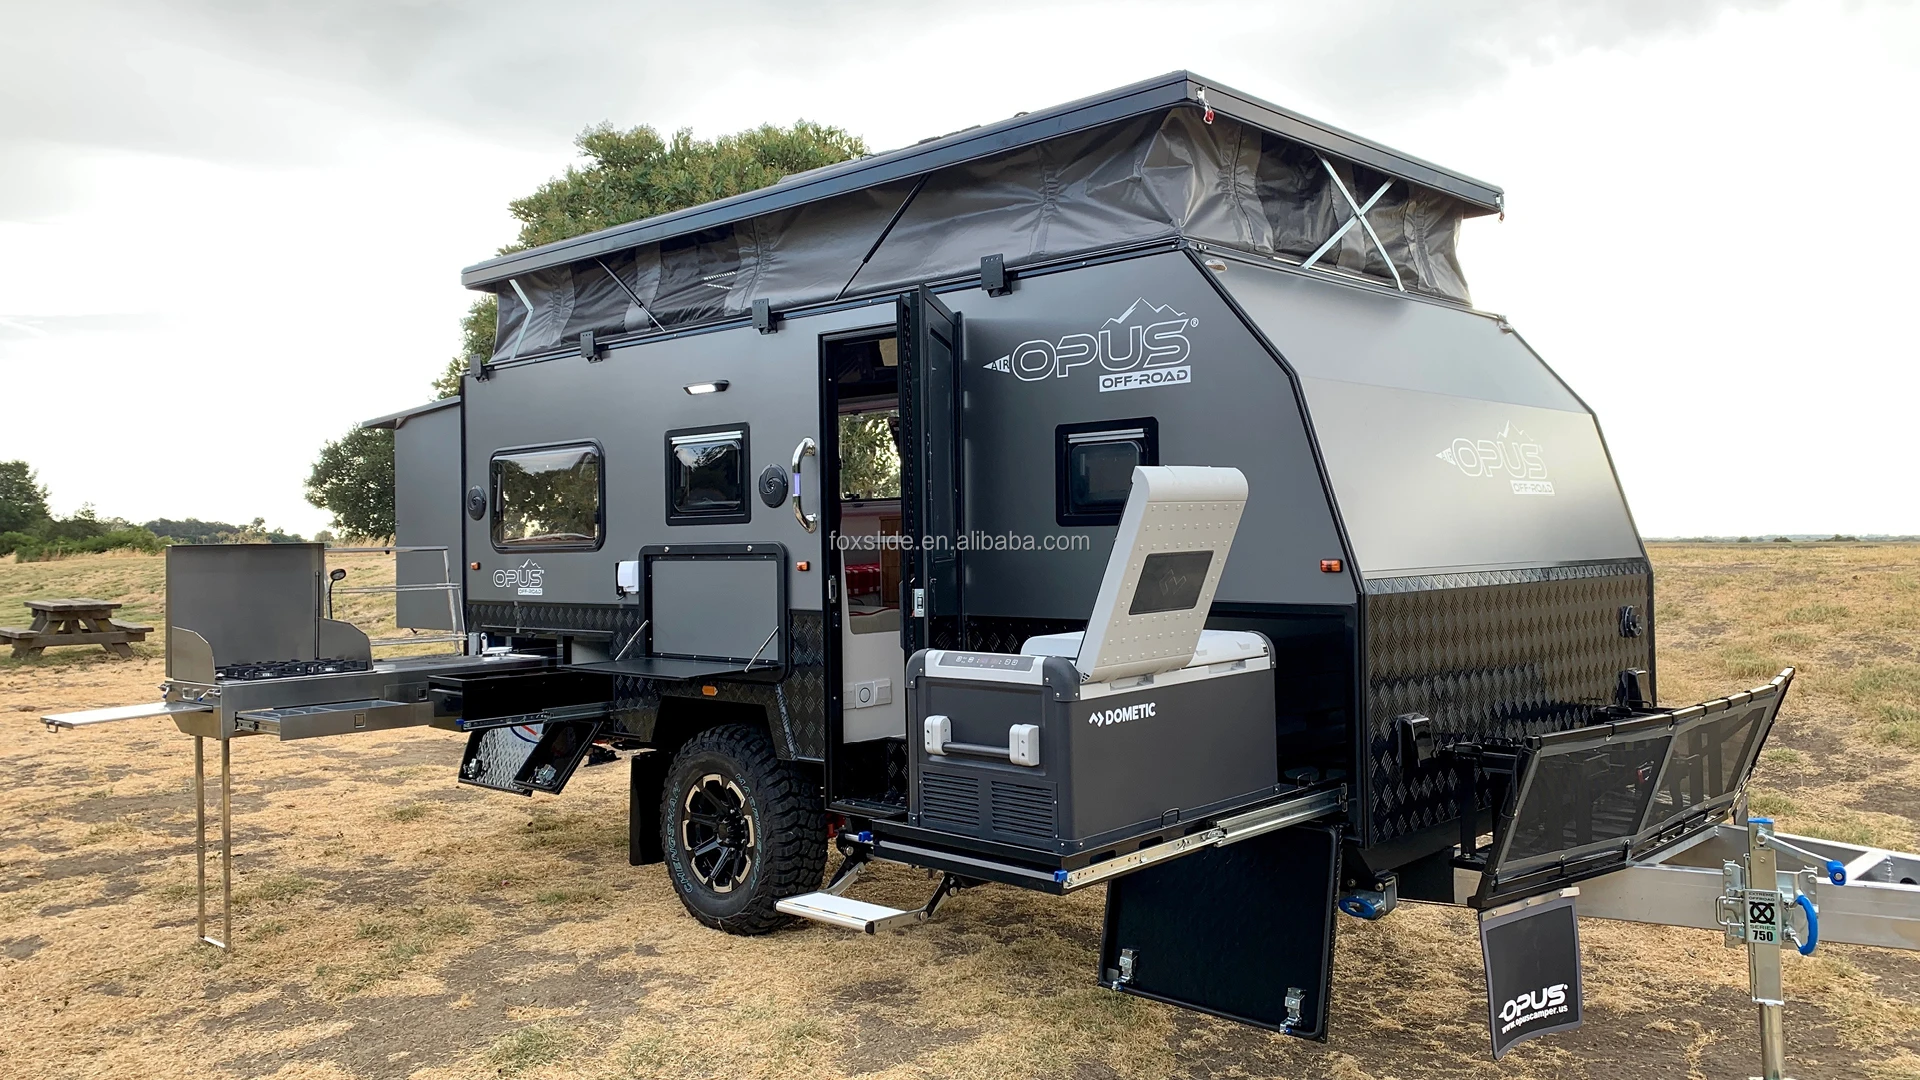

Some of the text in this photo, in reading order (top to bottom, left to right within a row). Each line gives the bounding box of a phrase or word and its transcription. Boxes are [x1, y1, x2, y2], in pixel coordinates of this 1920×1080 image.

[1101, 369, 1188, 389] OFF-ROAD
[1452, 438, 1548, 479] OPUS
[1512, 482, 1553, 493] OFF-ROAD
[493, 569, 543, 588] OPUS
[1105, 702, 1156, 726] DOMETIC
[667, 782, 694, 894] CHENGSHAN
[1752, 930, 1773, 941] 750
[1502, 983, 1566, 1022] OPUS
[1501, 1005, 1568, 1034] www.opuscamper.us
